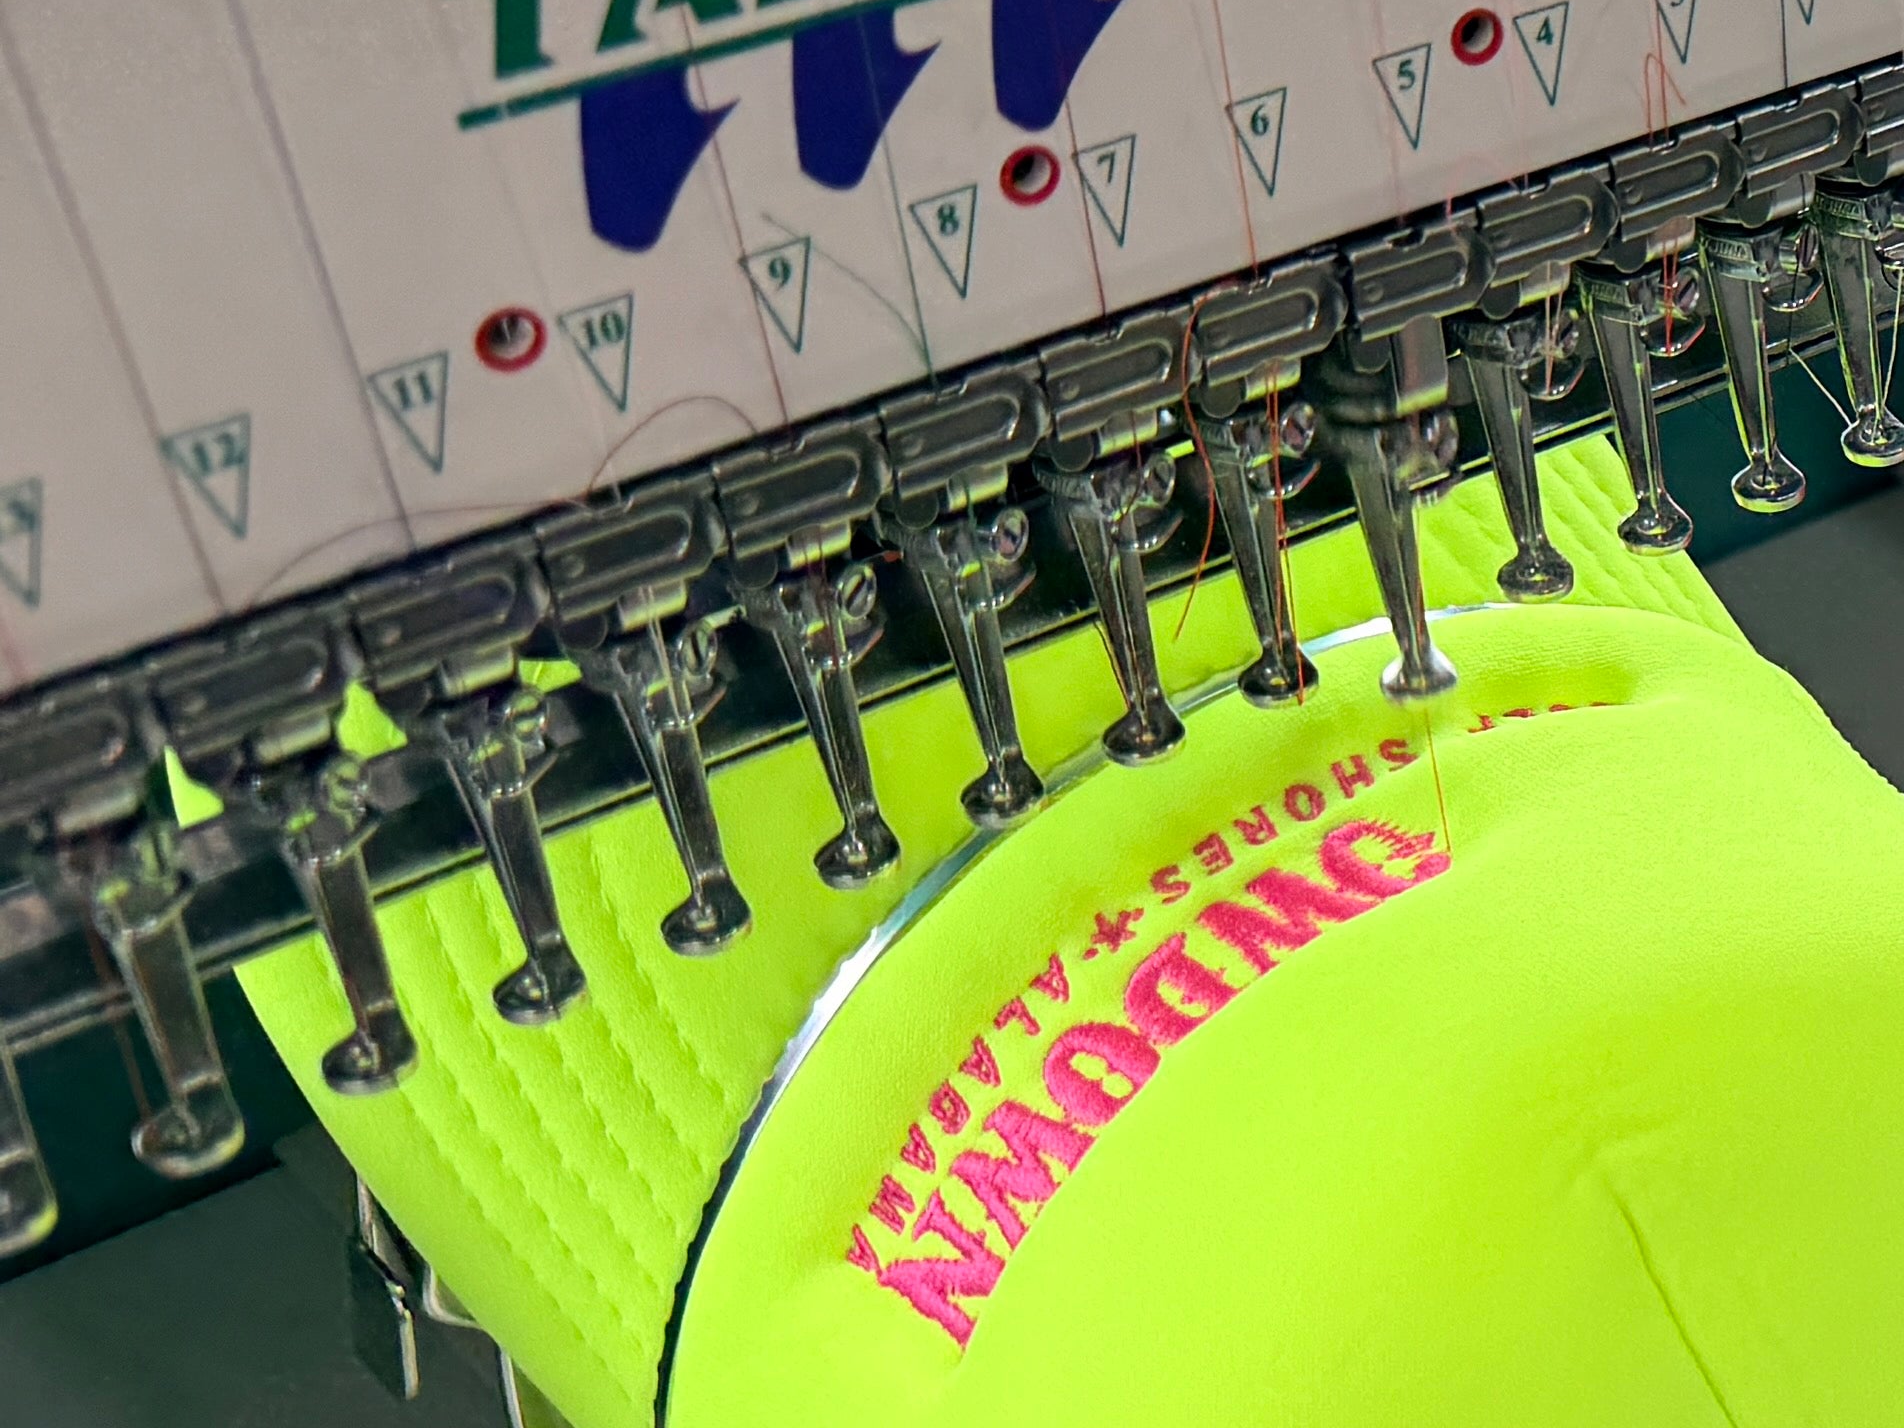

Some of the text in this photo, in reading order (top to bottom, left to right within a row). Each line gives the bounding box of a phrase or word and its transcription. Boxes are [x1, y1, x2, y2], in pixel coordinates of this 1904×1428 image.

[1535, 16, 1554, 46] 4
[1397, 58, 1416, 91] 5
[1250, 104, 1270, 136] 6
[1096, 151, 1116, 184] 7
[936, 202, 961, 236] 8
[767, 255, 793, 290] 9
[581, 310, 627, 352] 10
[393, 371, 435, 411] 11
[191, 430, 246, 478] 12
[845, 738, 1416, 1273] SHORES ALABAMA
